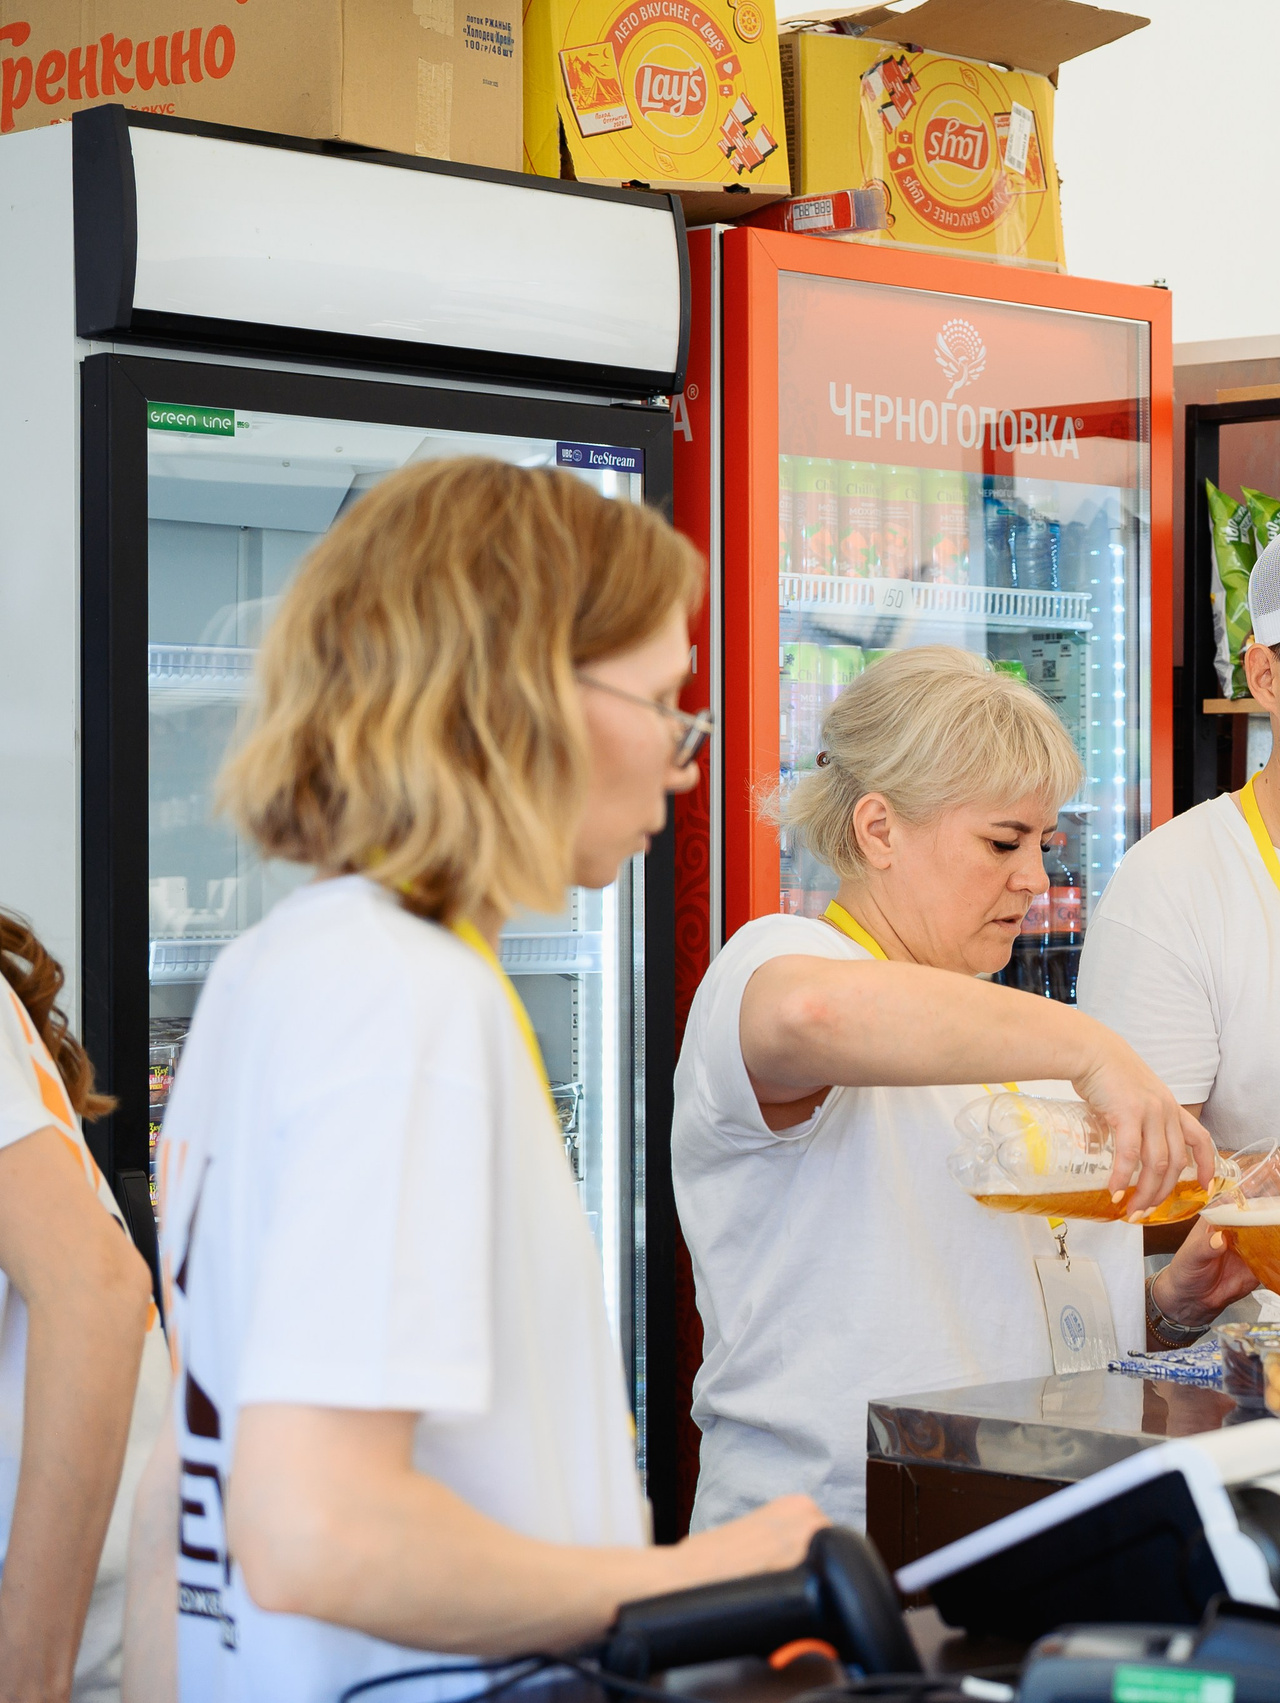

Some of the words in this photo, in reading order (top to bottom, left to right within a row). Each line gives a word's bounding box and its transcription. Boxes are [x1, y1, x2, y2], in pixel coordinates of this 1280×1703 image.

[613, 13, 640, 44] ЛЕТО
[639, 3, 690, 22] ВКУСНЕЕ
[699, 21, 727, 54] Lay's
[640, 66, 703, 117] Lay's
[927, 117, 985, 169] Lay's
[902, 175, 926, 205] Lay's
[933, 205, 981, 227] ВКУСНЕЕ
[981, 192, 1010, 218] ЛЕТО
[150, 411, 197, 426] Green
[203, 416, 232, 429] Line
[588, 450, 636, 467] IceStream
[882, 588, 904, 609] 150
